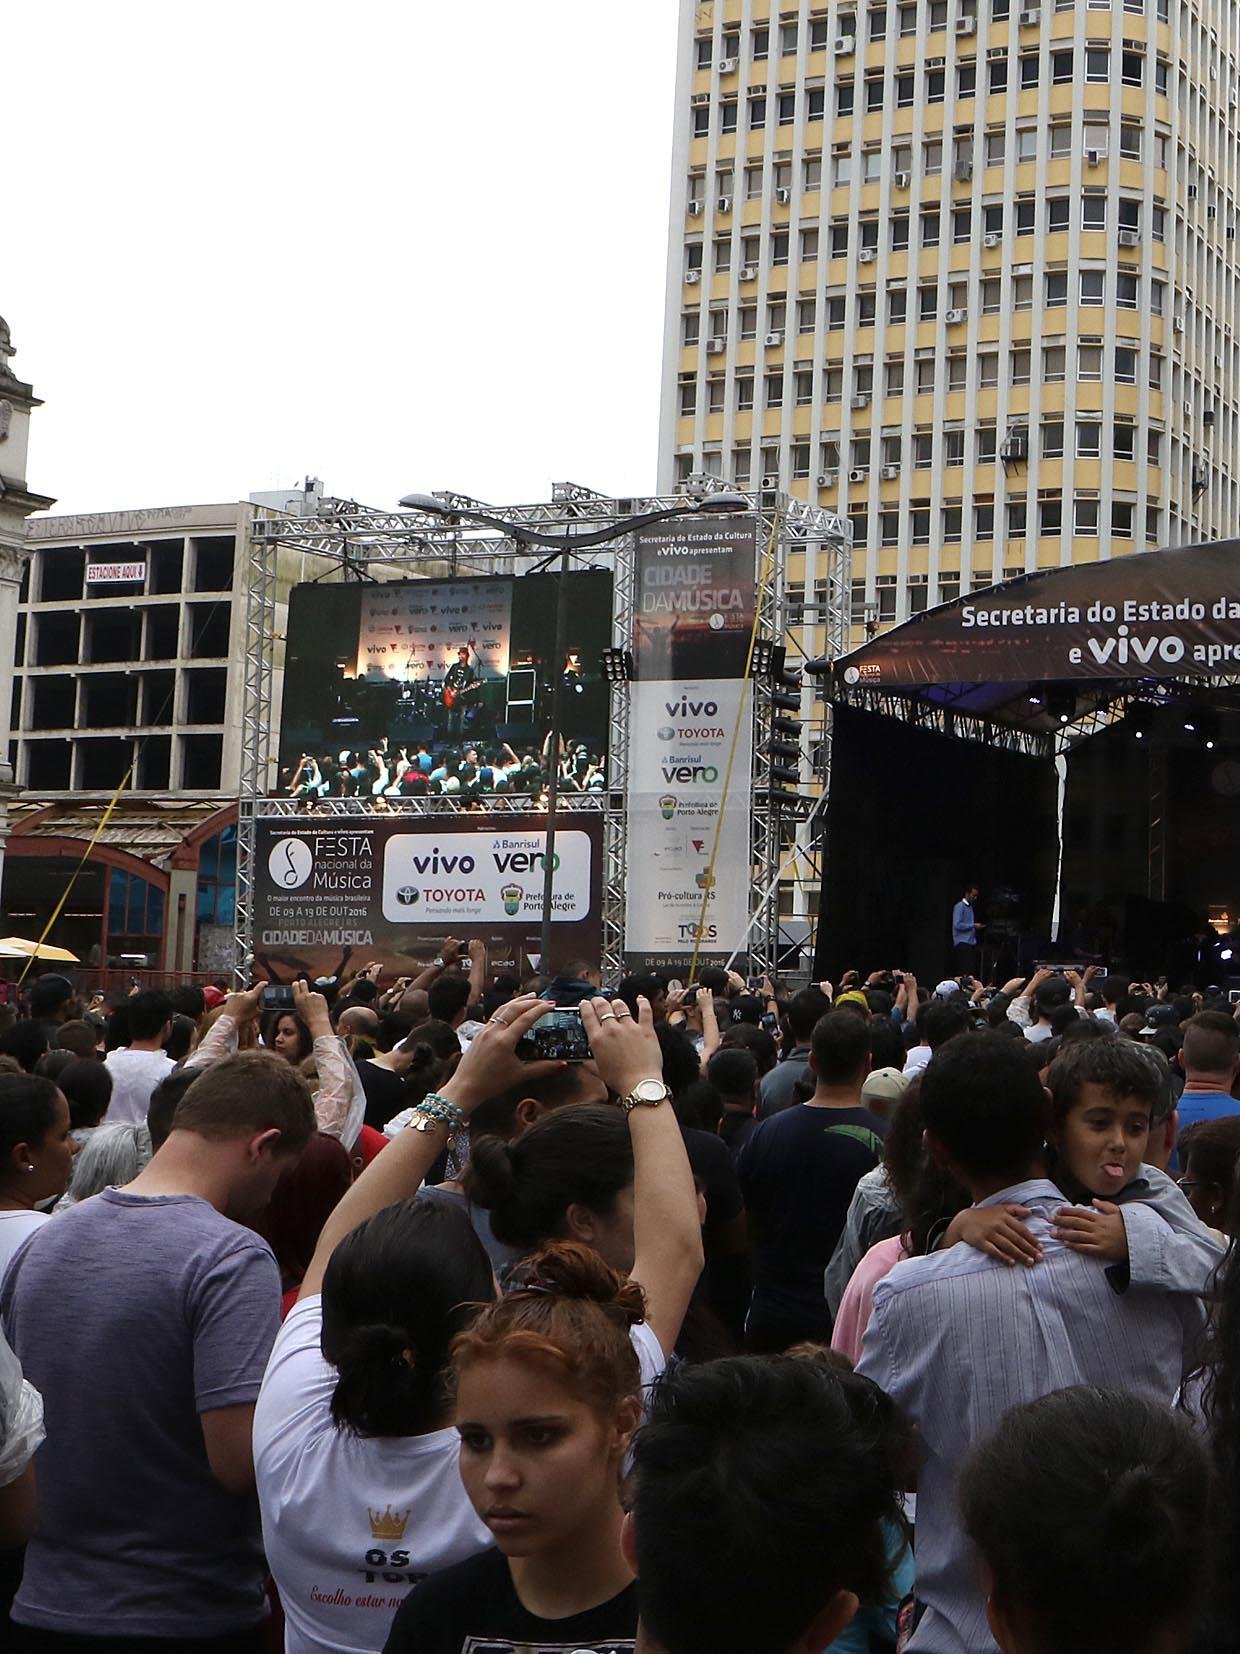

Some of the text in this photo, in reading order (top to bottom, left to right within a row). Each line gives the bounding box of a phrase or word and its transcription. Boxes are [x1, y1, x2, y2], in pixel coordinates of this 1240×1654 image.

[639, 535, 675, 543] Secretaria
[687, 533, 712, 541] Estado
[724, 531, 752, 540] Cultura
[662, 543, 689, 555] vivo
[689, 546, 733, 556] apresentam
[88, 566, 121, 580] ESTACIONE
[644, 564, 712, 586] CIDADE
[962, 602, 1079, 628] Secretaria
[1087, 600, 1116, 623] do
[1124, 597, 1204, 623] Estado
[1212, 595, 1240, 620] da
[1069, 646, 1081, 665] e
[1088, 625, 1185, 665] vivo
[665, 695, 718, 717] vivo
[678, 728, 725, 739] TOYOTA
[669, 755, 702, 764] Banrisul
[662, 766, 718, 784] vero
[315, 837, 373, 856] FESTA
[502, 839, 540, 849] Banrisul
[314, 859, 372, 869] nacional da
[412, 848, 475, 874] vivo
[313, 872, 372, 889] Música
[423, 888, 486, 902] TOYOTA
[566, 892, 574, 900] de
[658, 891, 702, 900] Pró-cultura
[269, 906, 280, 916] DE
[283, 908, 294, 918] 09
[296, 907, 302, 916] A
[305, 908, 314, 918] 19
[316, 906, 328, 916] DE
[645, 958, 656, 966] DE
[365, 1548, 411, 1567] OS
[310, 1584, 385, 1608] Escolho estar
